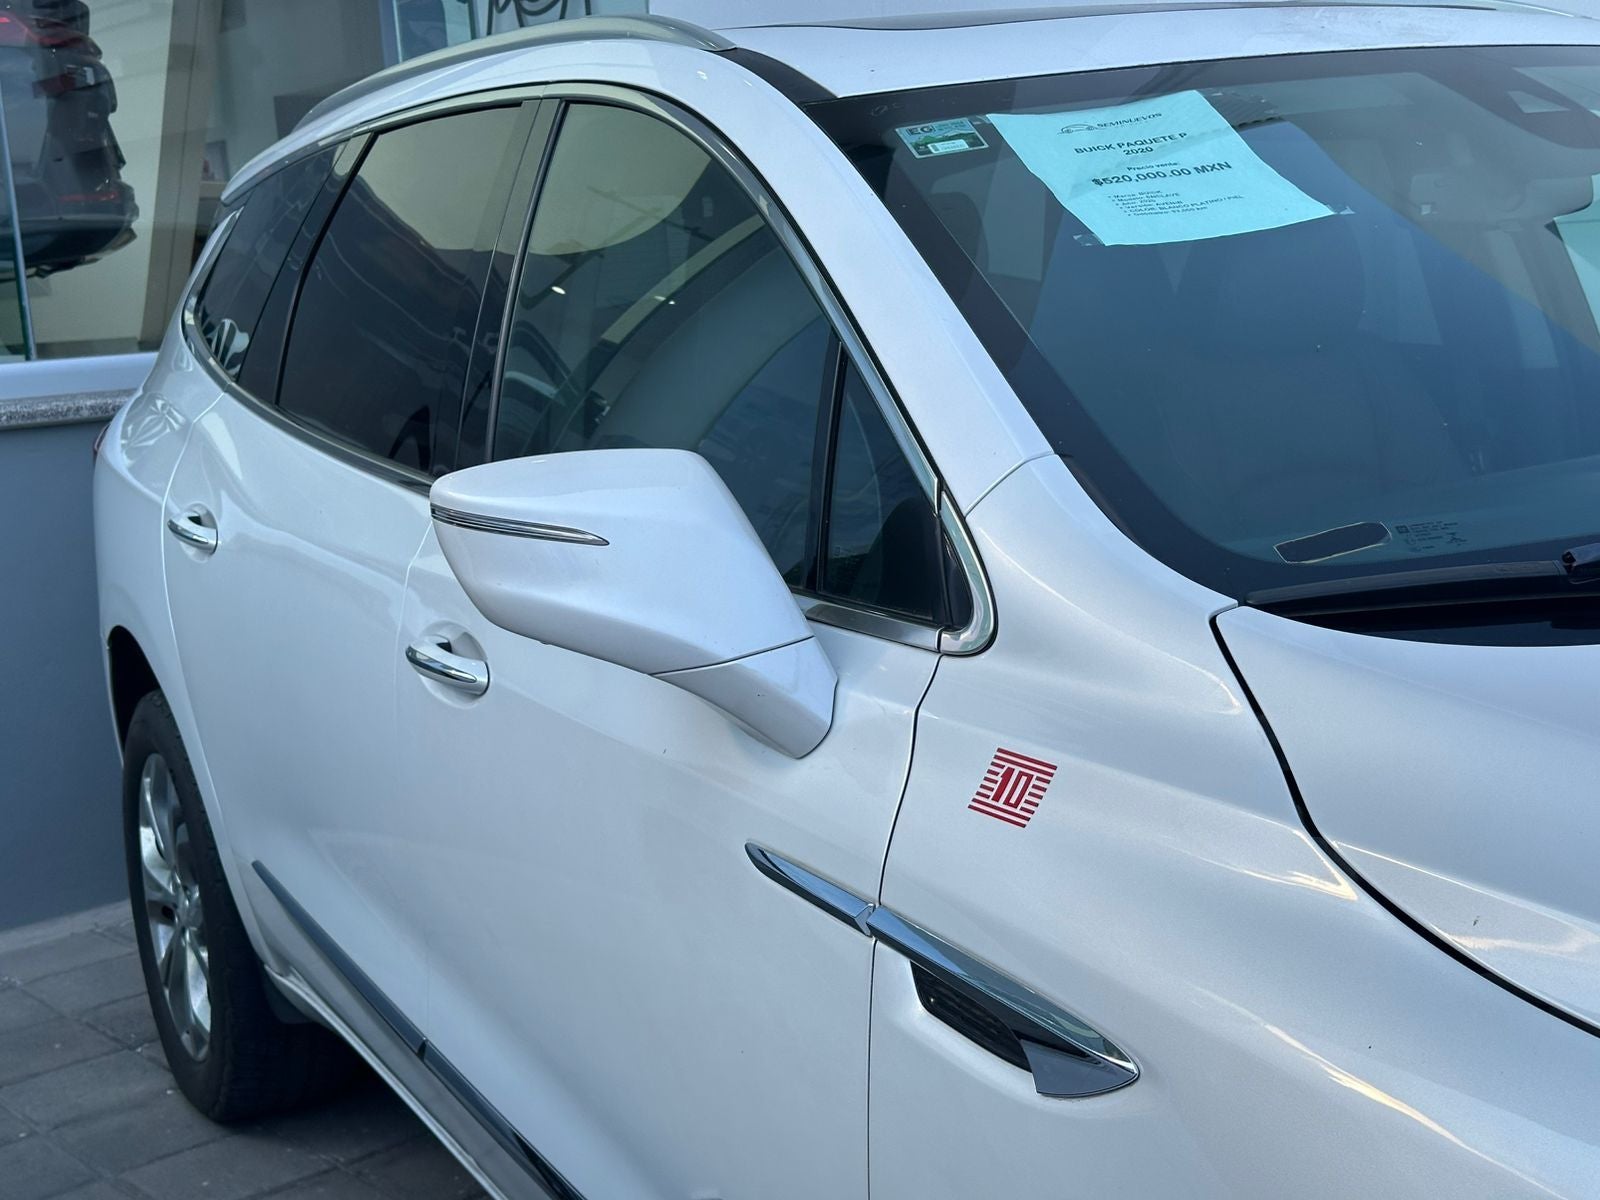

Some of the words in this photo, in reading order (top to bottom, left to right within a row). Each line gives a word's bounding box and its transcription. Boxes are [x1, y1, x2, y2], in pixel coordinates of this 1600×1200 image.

[1096, 112, 1162, 128] SEMINUEVOS
[1074, 143, 1115, 154] BUICK
[1116, 134, 1177, 149] PAQUETE
[1123, 146, 1154, 155] 2020
[1092, 168, 1191, 186] $520,000.00
[1194, 161, 1232, 175] MXN
[1158, 203, 1190, 211] BLANCO
[1190, 197, 1223, 207] PLATINO
[991, 766, 1034, 809] 10
